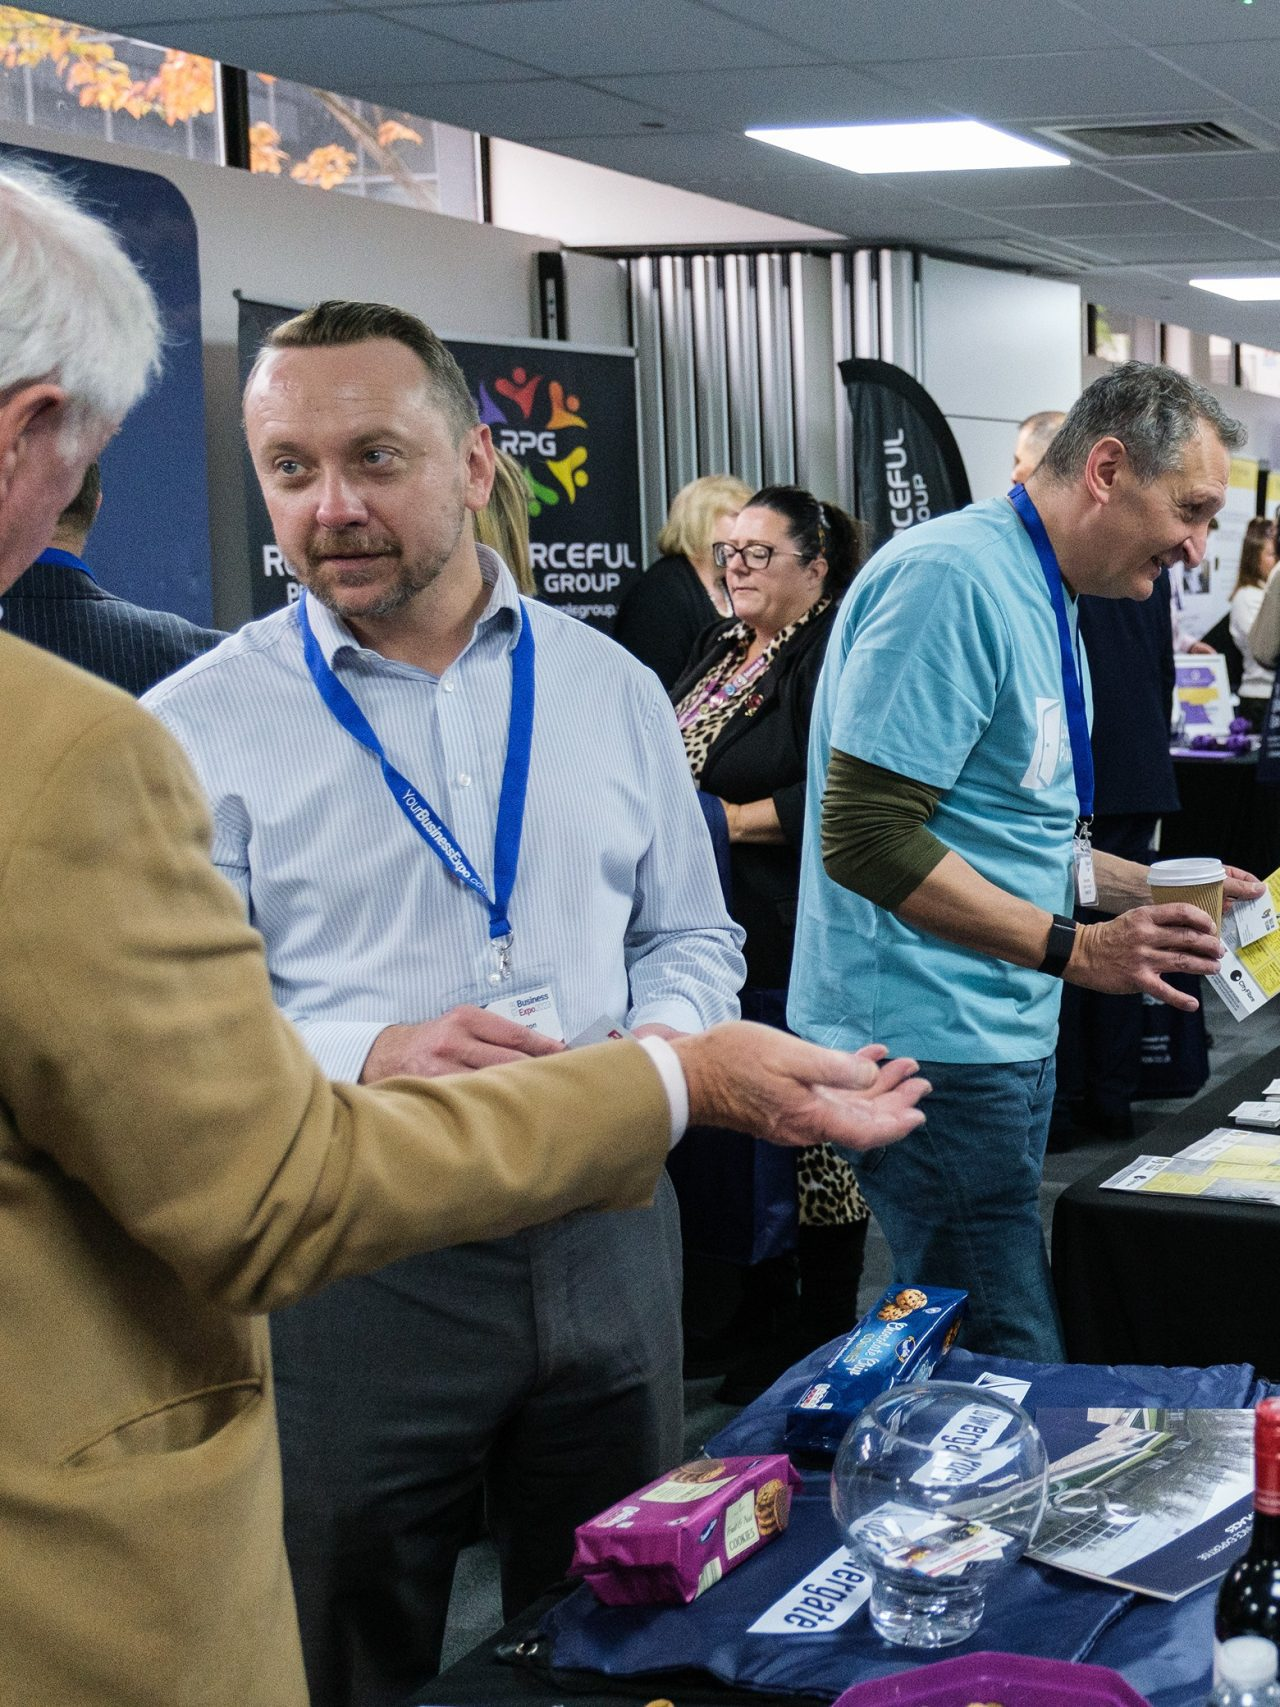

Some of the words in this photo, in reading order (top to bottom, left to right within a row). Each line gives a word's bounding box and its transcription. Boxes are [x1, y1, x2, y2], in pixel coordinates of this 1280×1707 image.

[500, 430, 556, 456] RPG
[912, 474, 931, 522] OUP
[529, 543, 636, 569] RCEFUL
[544, 572, 620, 593] GROUP
[516, 992, 549, 1008] Business
[519, 1005, 536, 1016] Expo
